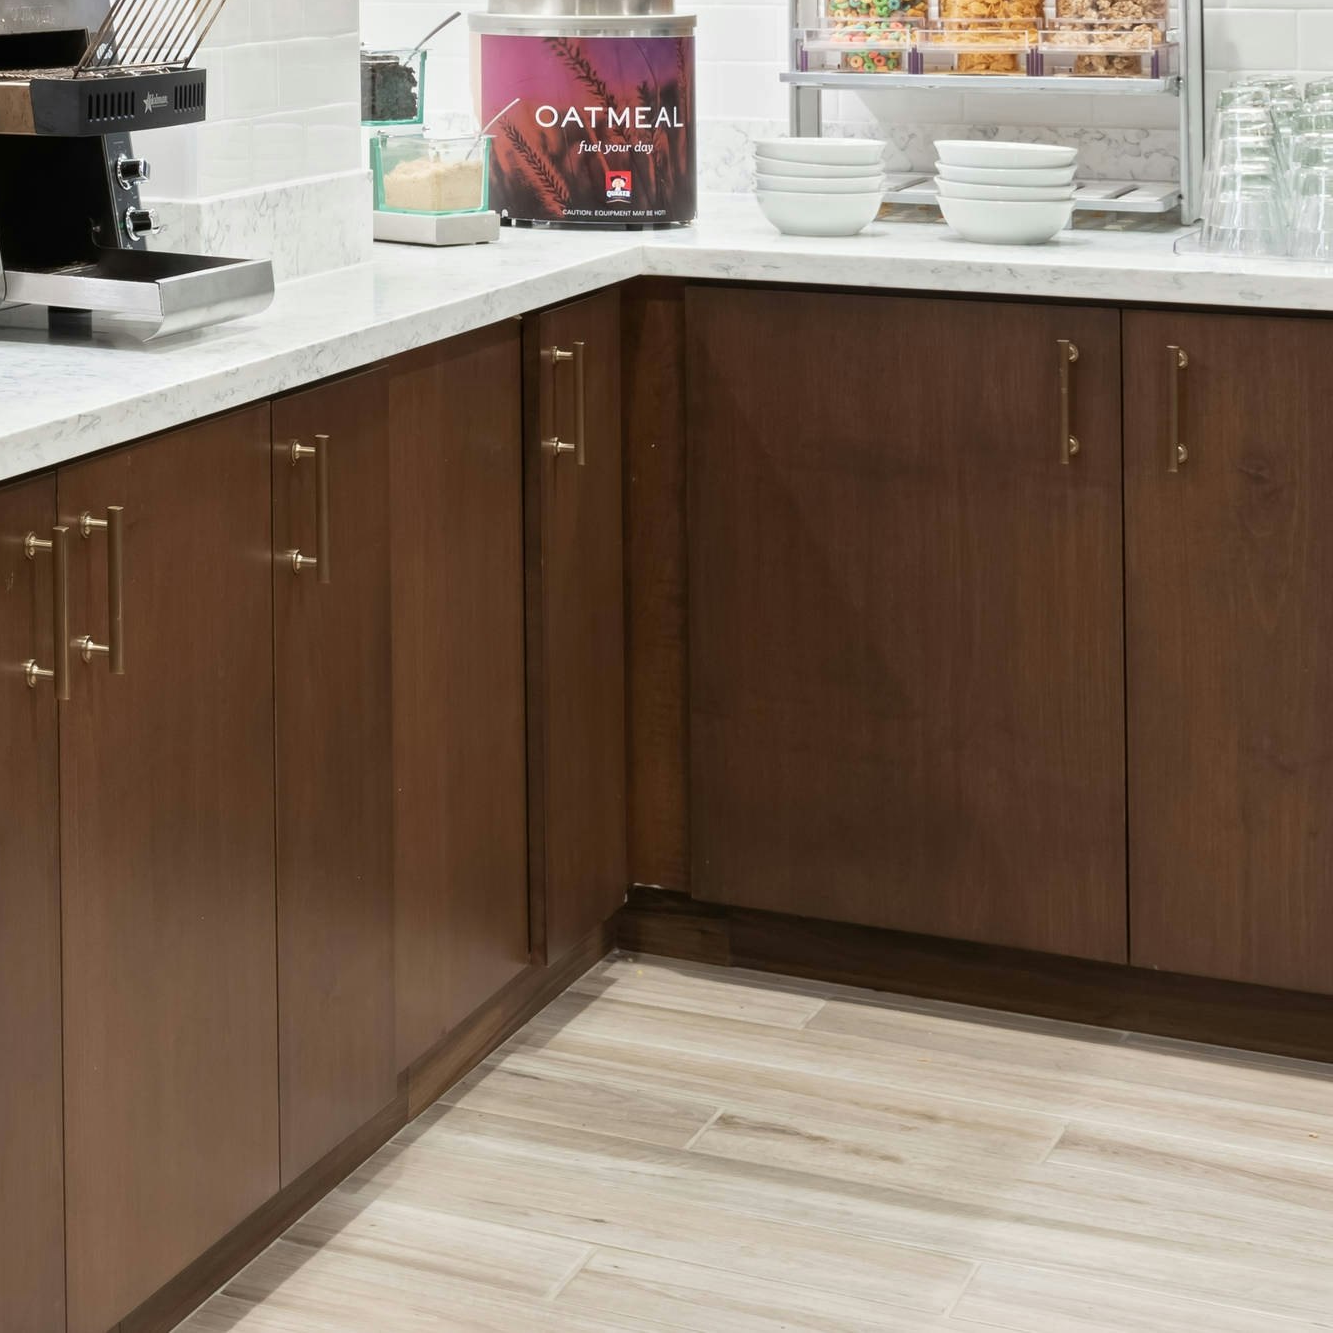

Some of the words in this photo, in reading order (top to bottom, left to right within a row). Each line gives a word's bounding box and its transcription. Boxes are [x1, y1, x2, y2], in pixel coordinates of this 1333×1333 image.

[535, 105, 684, 128] OATMEAL
[578, 140, 601, 154] fuel
[604, 143, 631, 154] your
[634, 141, 654, 154] day
